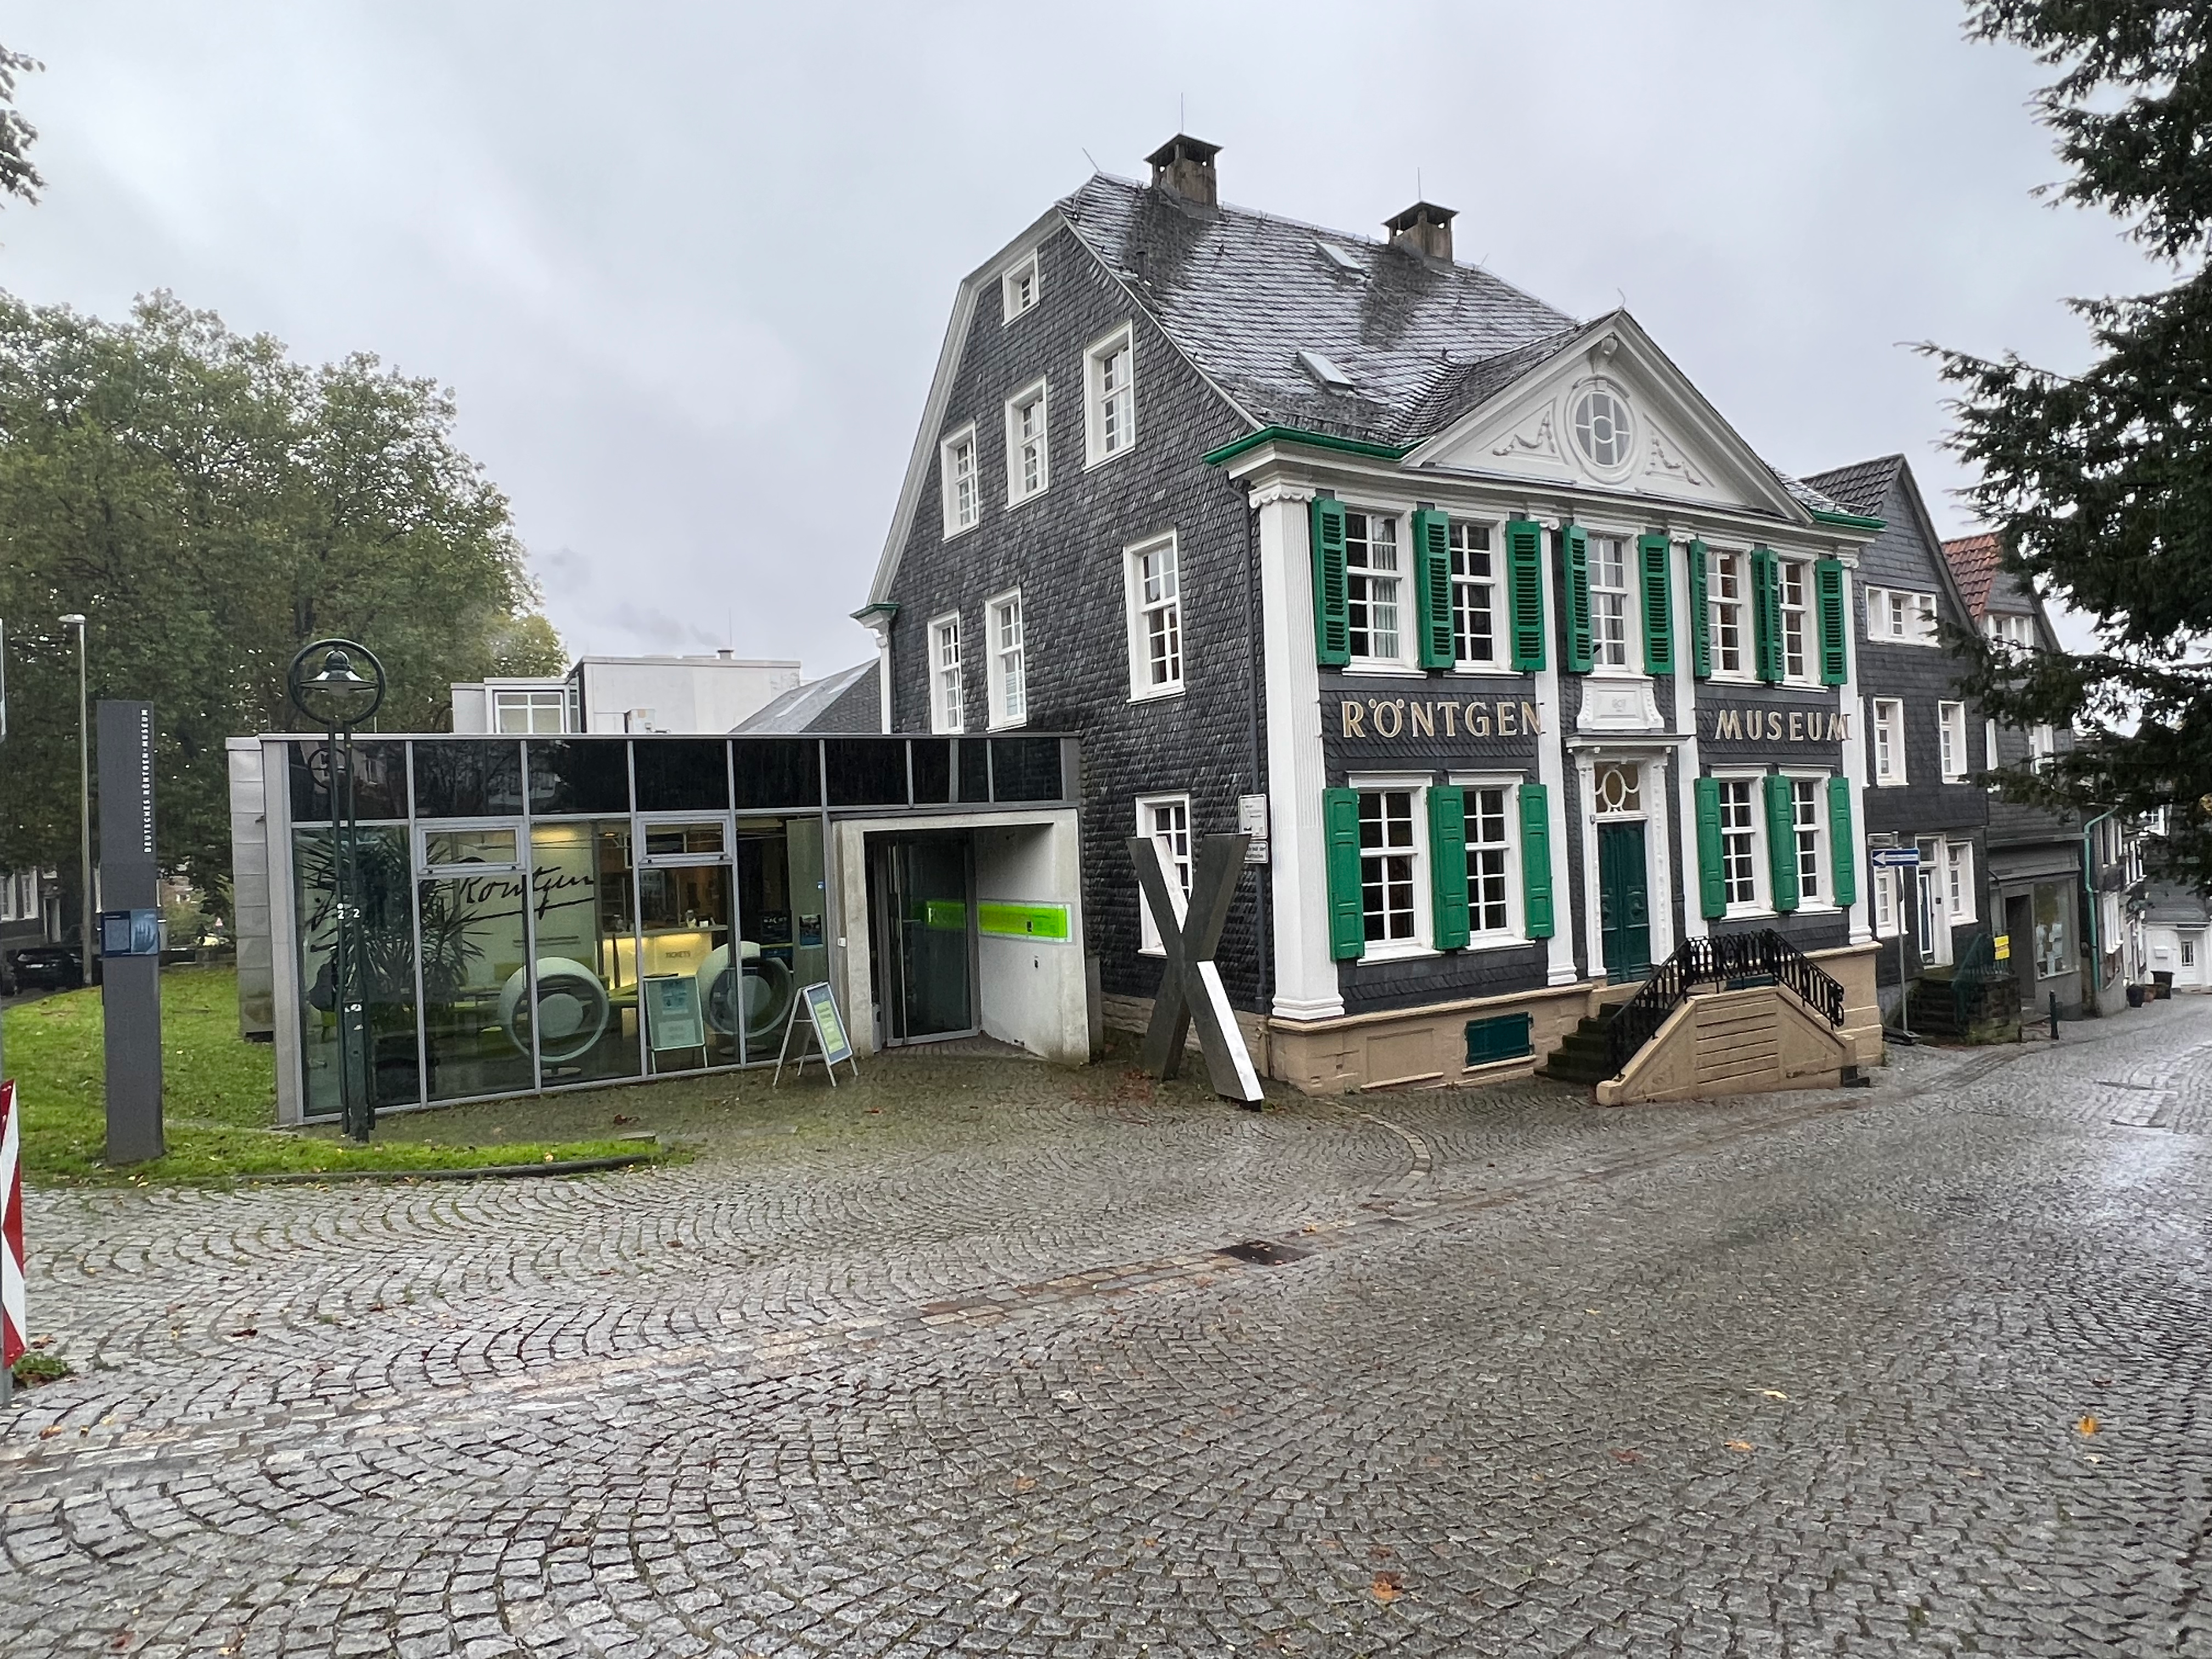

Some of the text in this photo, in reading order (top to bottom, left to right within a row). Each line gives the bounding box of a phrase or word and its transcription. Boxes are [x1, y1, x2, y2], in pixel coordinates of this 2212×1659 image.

[1341, 698, 1852, 741] RÖNTGEN MUSEUM
[143, 799, 152, 853] DEUTSCHES
[353, 909, 360, 918] 2
